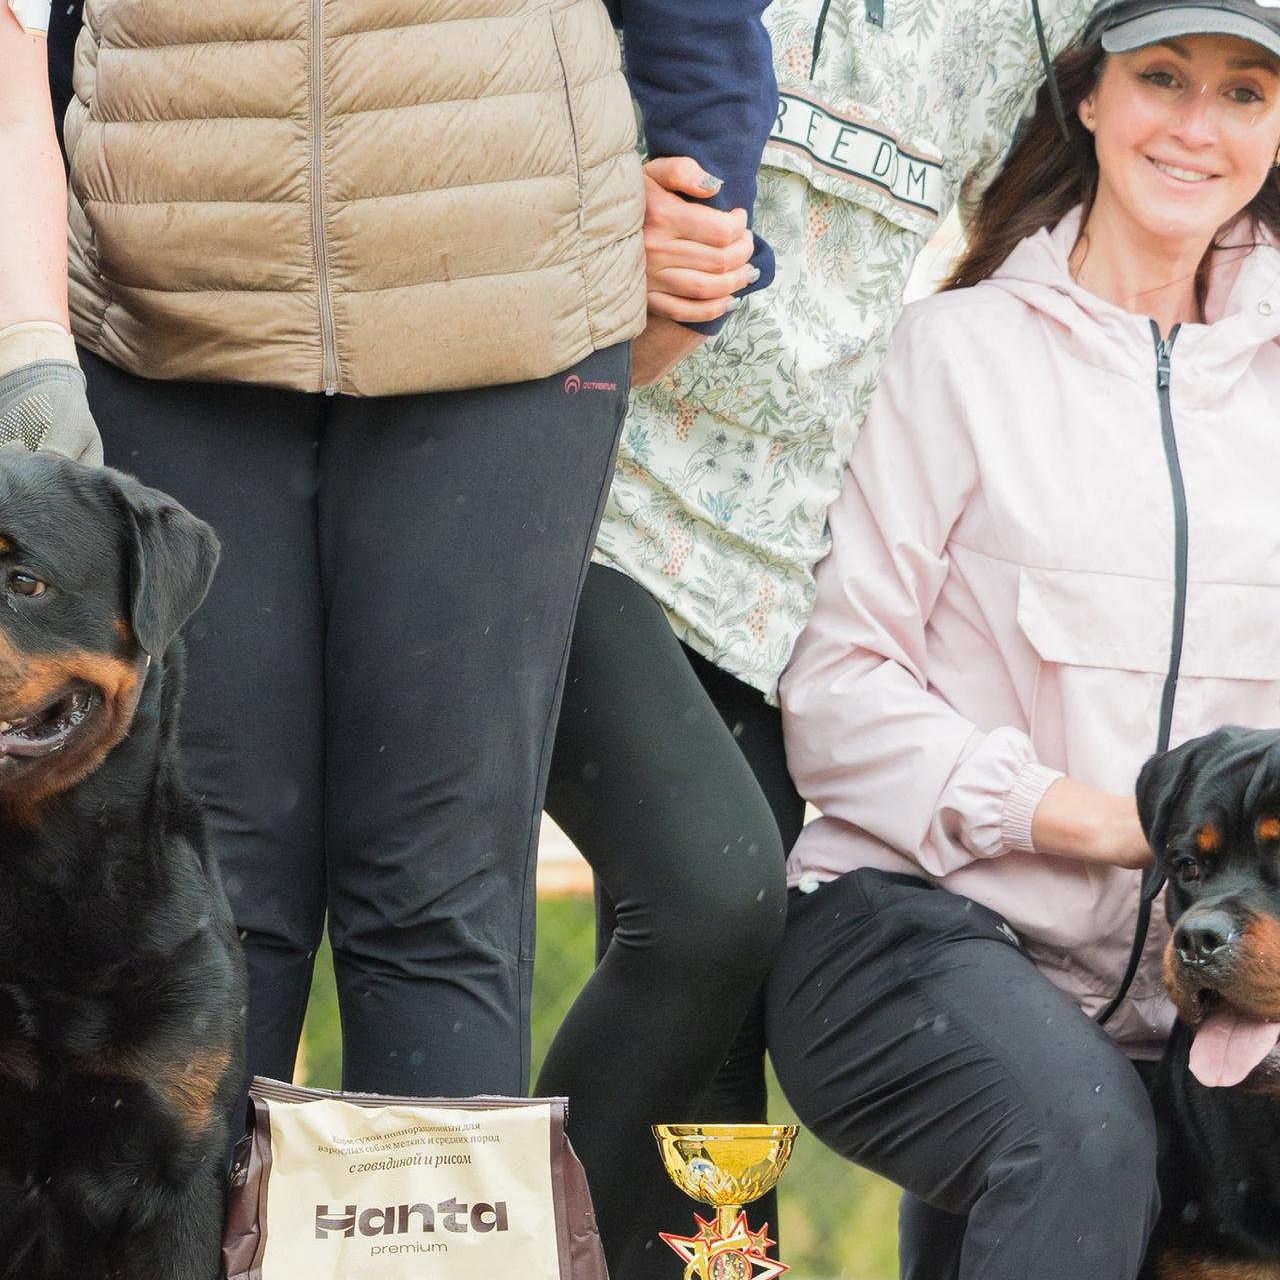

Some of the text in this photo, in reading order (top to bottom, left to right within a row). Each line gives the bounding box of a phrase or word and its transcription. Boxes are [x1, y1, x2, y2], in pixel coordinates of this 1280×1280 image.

[355, 1133, 383, 1146] сухой
[462, 1123, 481, 1132] для
[365, 1141, 392, 1153] собак
[434, 1135, 469, 1146] средних
[470, 1134, 500, 1144] пород
[349, 1153, 472, 1173] с говядиной и рисом
[315, 1197, 509, 1239] Hanta
[370, 1241, 448, 1257] premium
